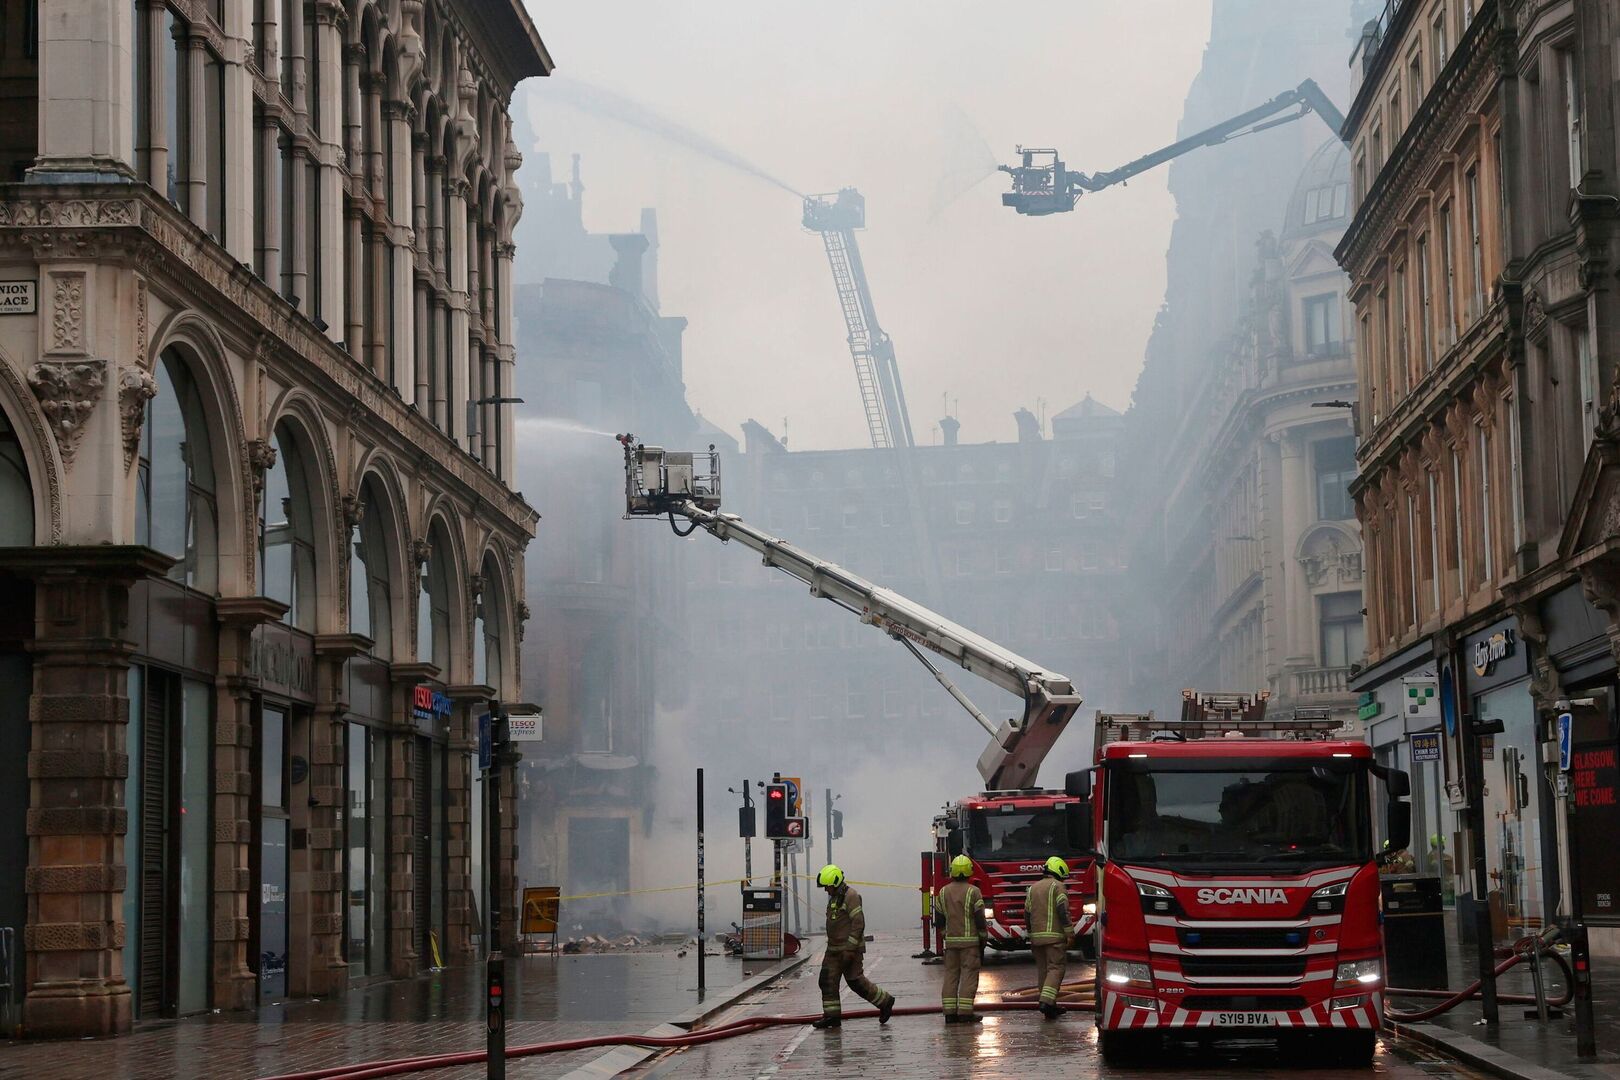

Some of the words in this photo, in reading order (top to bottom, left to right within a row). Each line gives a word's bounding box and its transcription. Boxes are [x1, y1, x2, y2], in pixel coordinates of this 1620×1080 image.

[414, 686, 432, 709] TESCO
[1414, 748, 1429, 756] CHINA
[1429, 747, 1439, 755] SEA
[1574, 750, 1616, 768] GLASGOW,
[1575, 771, 1596, 787] HERE
[1576, 790, 1589, 806] WE
[1590, 787, 1616, 805] COME.
[1196, 888, 1289, 905] SCANIA
[1219, 1013, 1244, 1024] SY19
[1247, 1013, 1270, 1024] BVA
